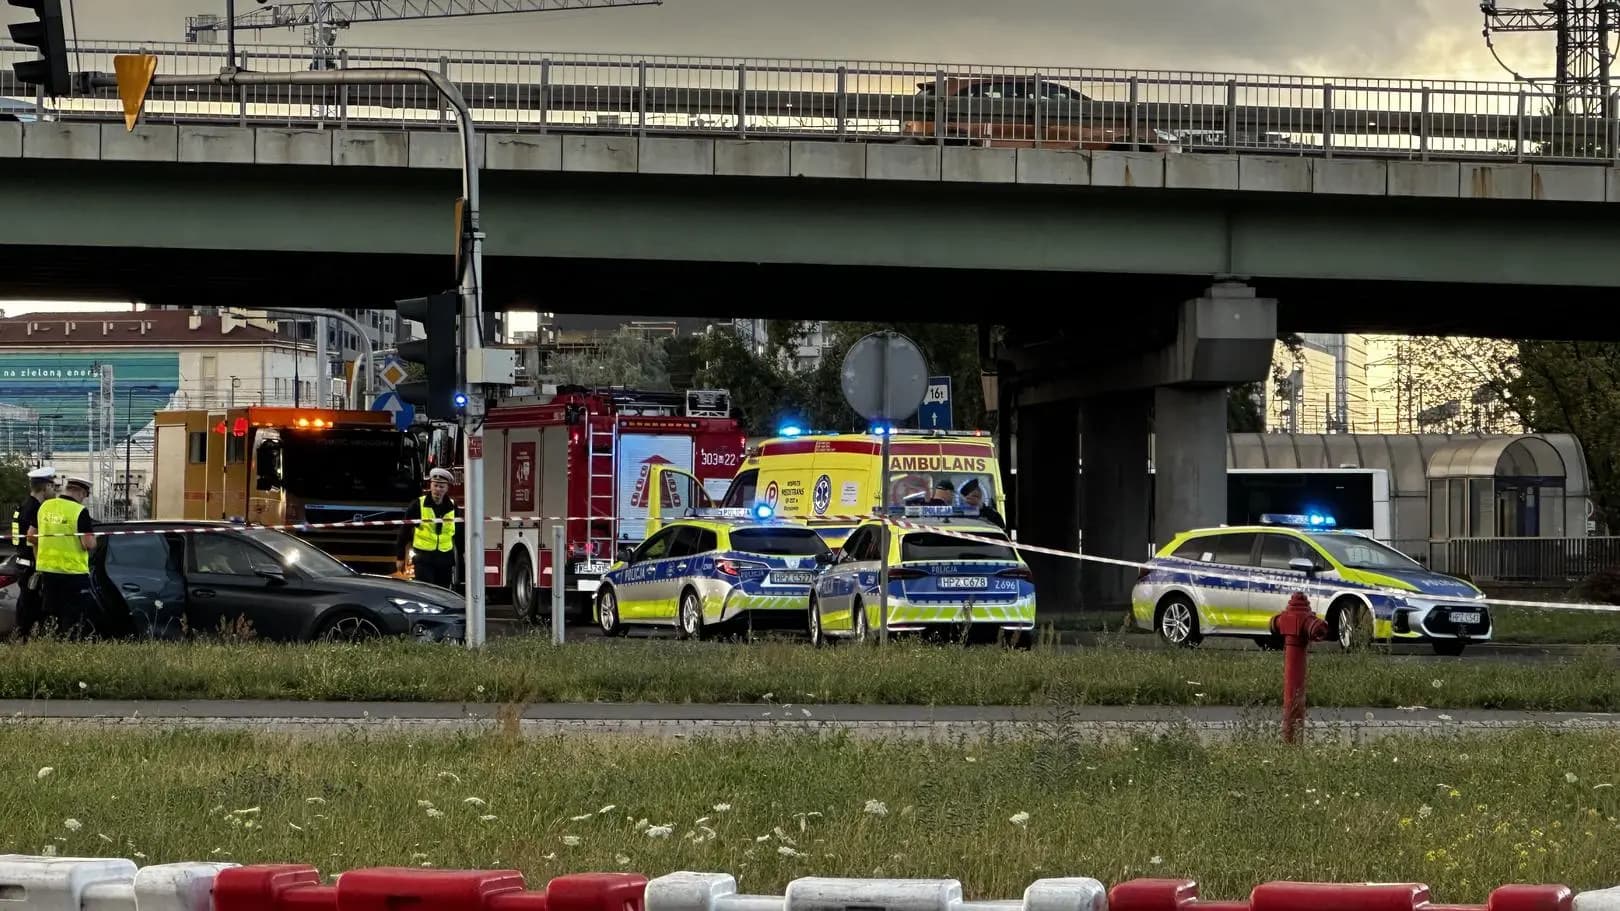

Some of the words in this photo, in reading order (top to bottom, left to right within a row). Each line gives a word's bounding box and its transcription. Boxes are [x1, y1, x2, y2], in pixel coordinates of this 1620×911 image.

[890, 457, 986, 472] AMBULANS
[624, 567, 646, 581] POLICJA
[931, 566, 958, 574] POLICJA
[995, 580, 1016, 590] Z696
